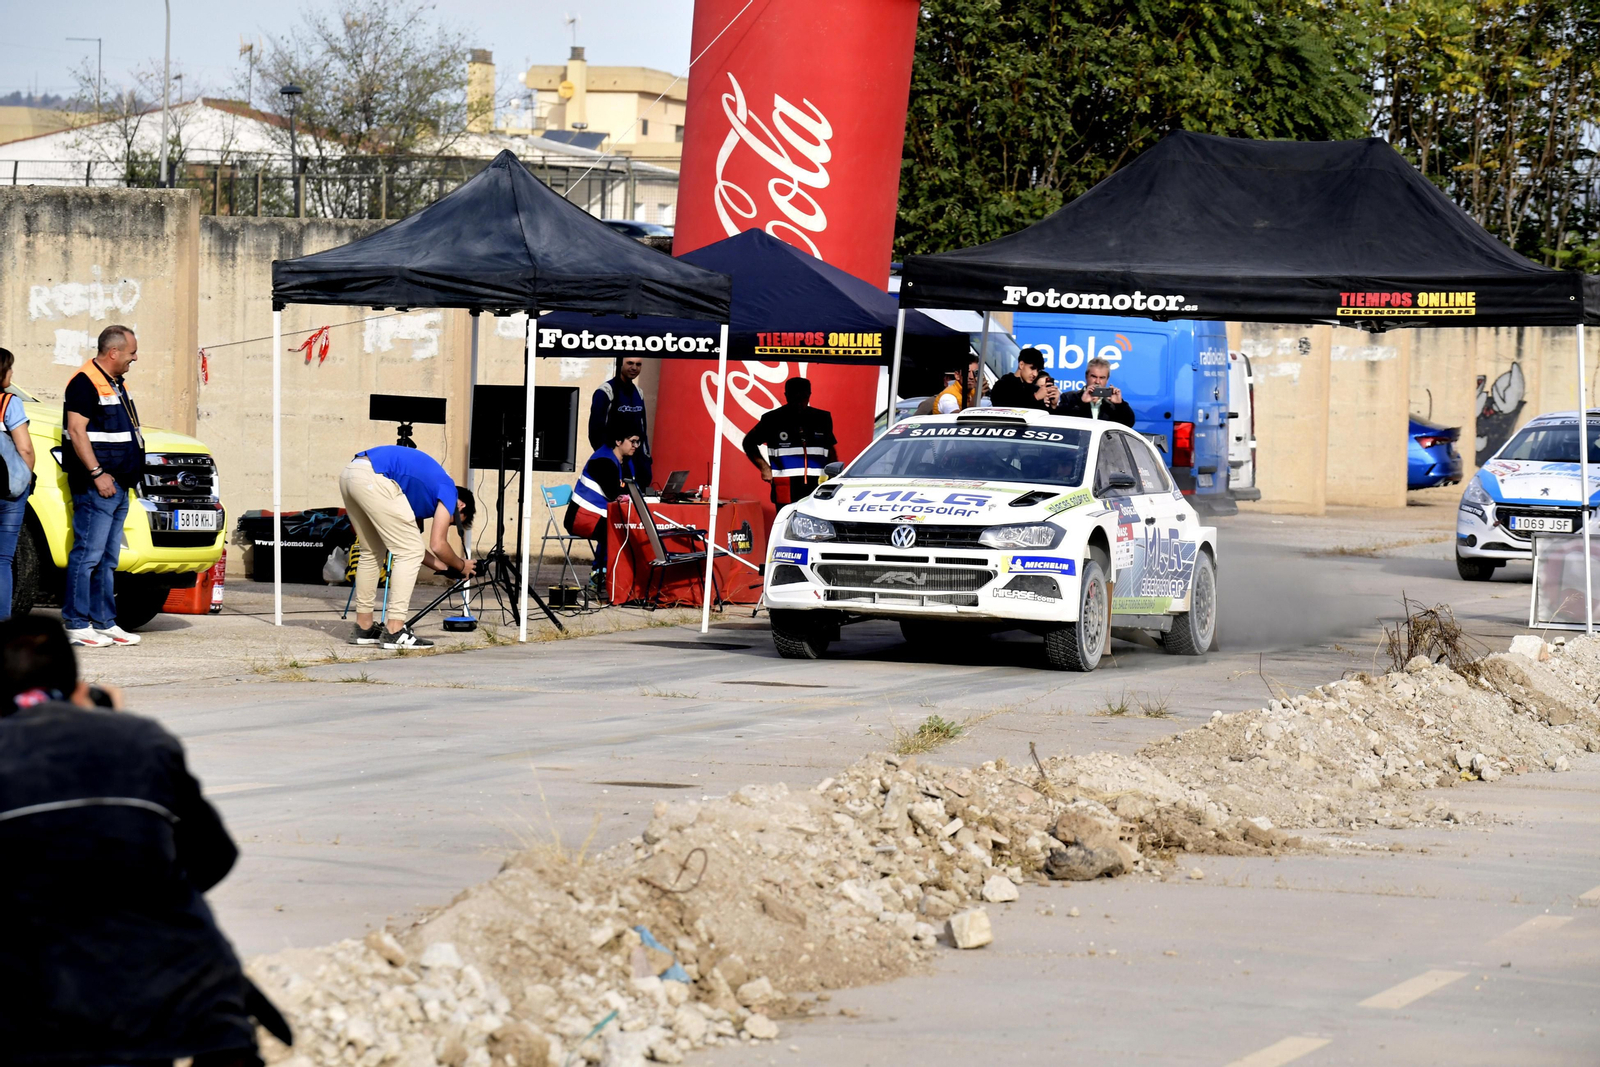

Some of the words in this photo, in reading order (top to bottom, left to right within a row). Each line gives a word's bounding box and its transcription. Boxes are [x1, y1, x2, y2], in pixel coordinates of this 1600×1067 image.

[1002, 285, 1198, 311] Fotomotor.es
[1340, 292, 1412, 307] TIEMPOS
[1417, 292, 1476, 307] ONLINE
[538, 328, 721, 353] Fotomotor.e
[756, 332, 824, 347] TIEMPOS
[828, 332, 882, 347] ONLINE
[757, 346, 880, 355] CRONOMETRAJE
[909, 427, 1017, 437] SAMSUNG
[1022, 430, 1064, 441] SSD
[181, 514, 199, 527] 5818
[200, 514, 214, 527] KHJ
[1518, 518, 1545, 529] 1069
[1549, 520, 1570, 530] JSF
[775, 551, 802, 560] MICHELIN
[1024, 560, 1069, 571] MICHELIN
